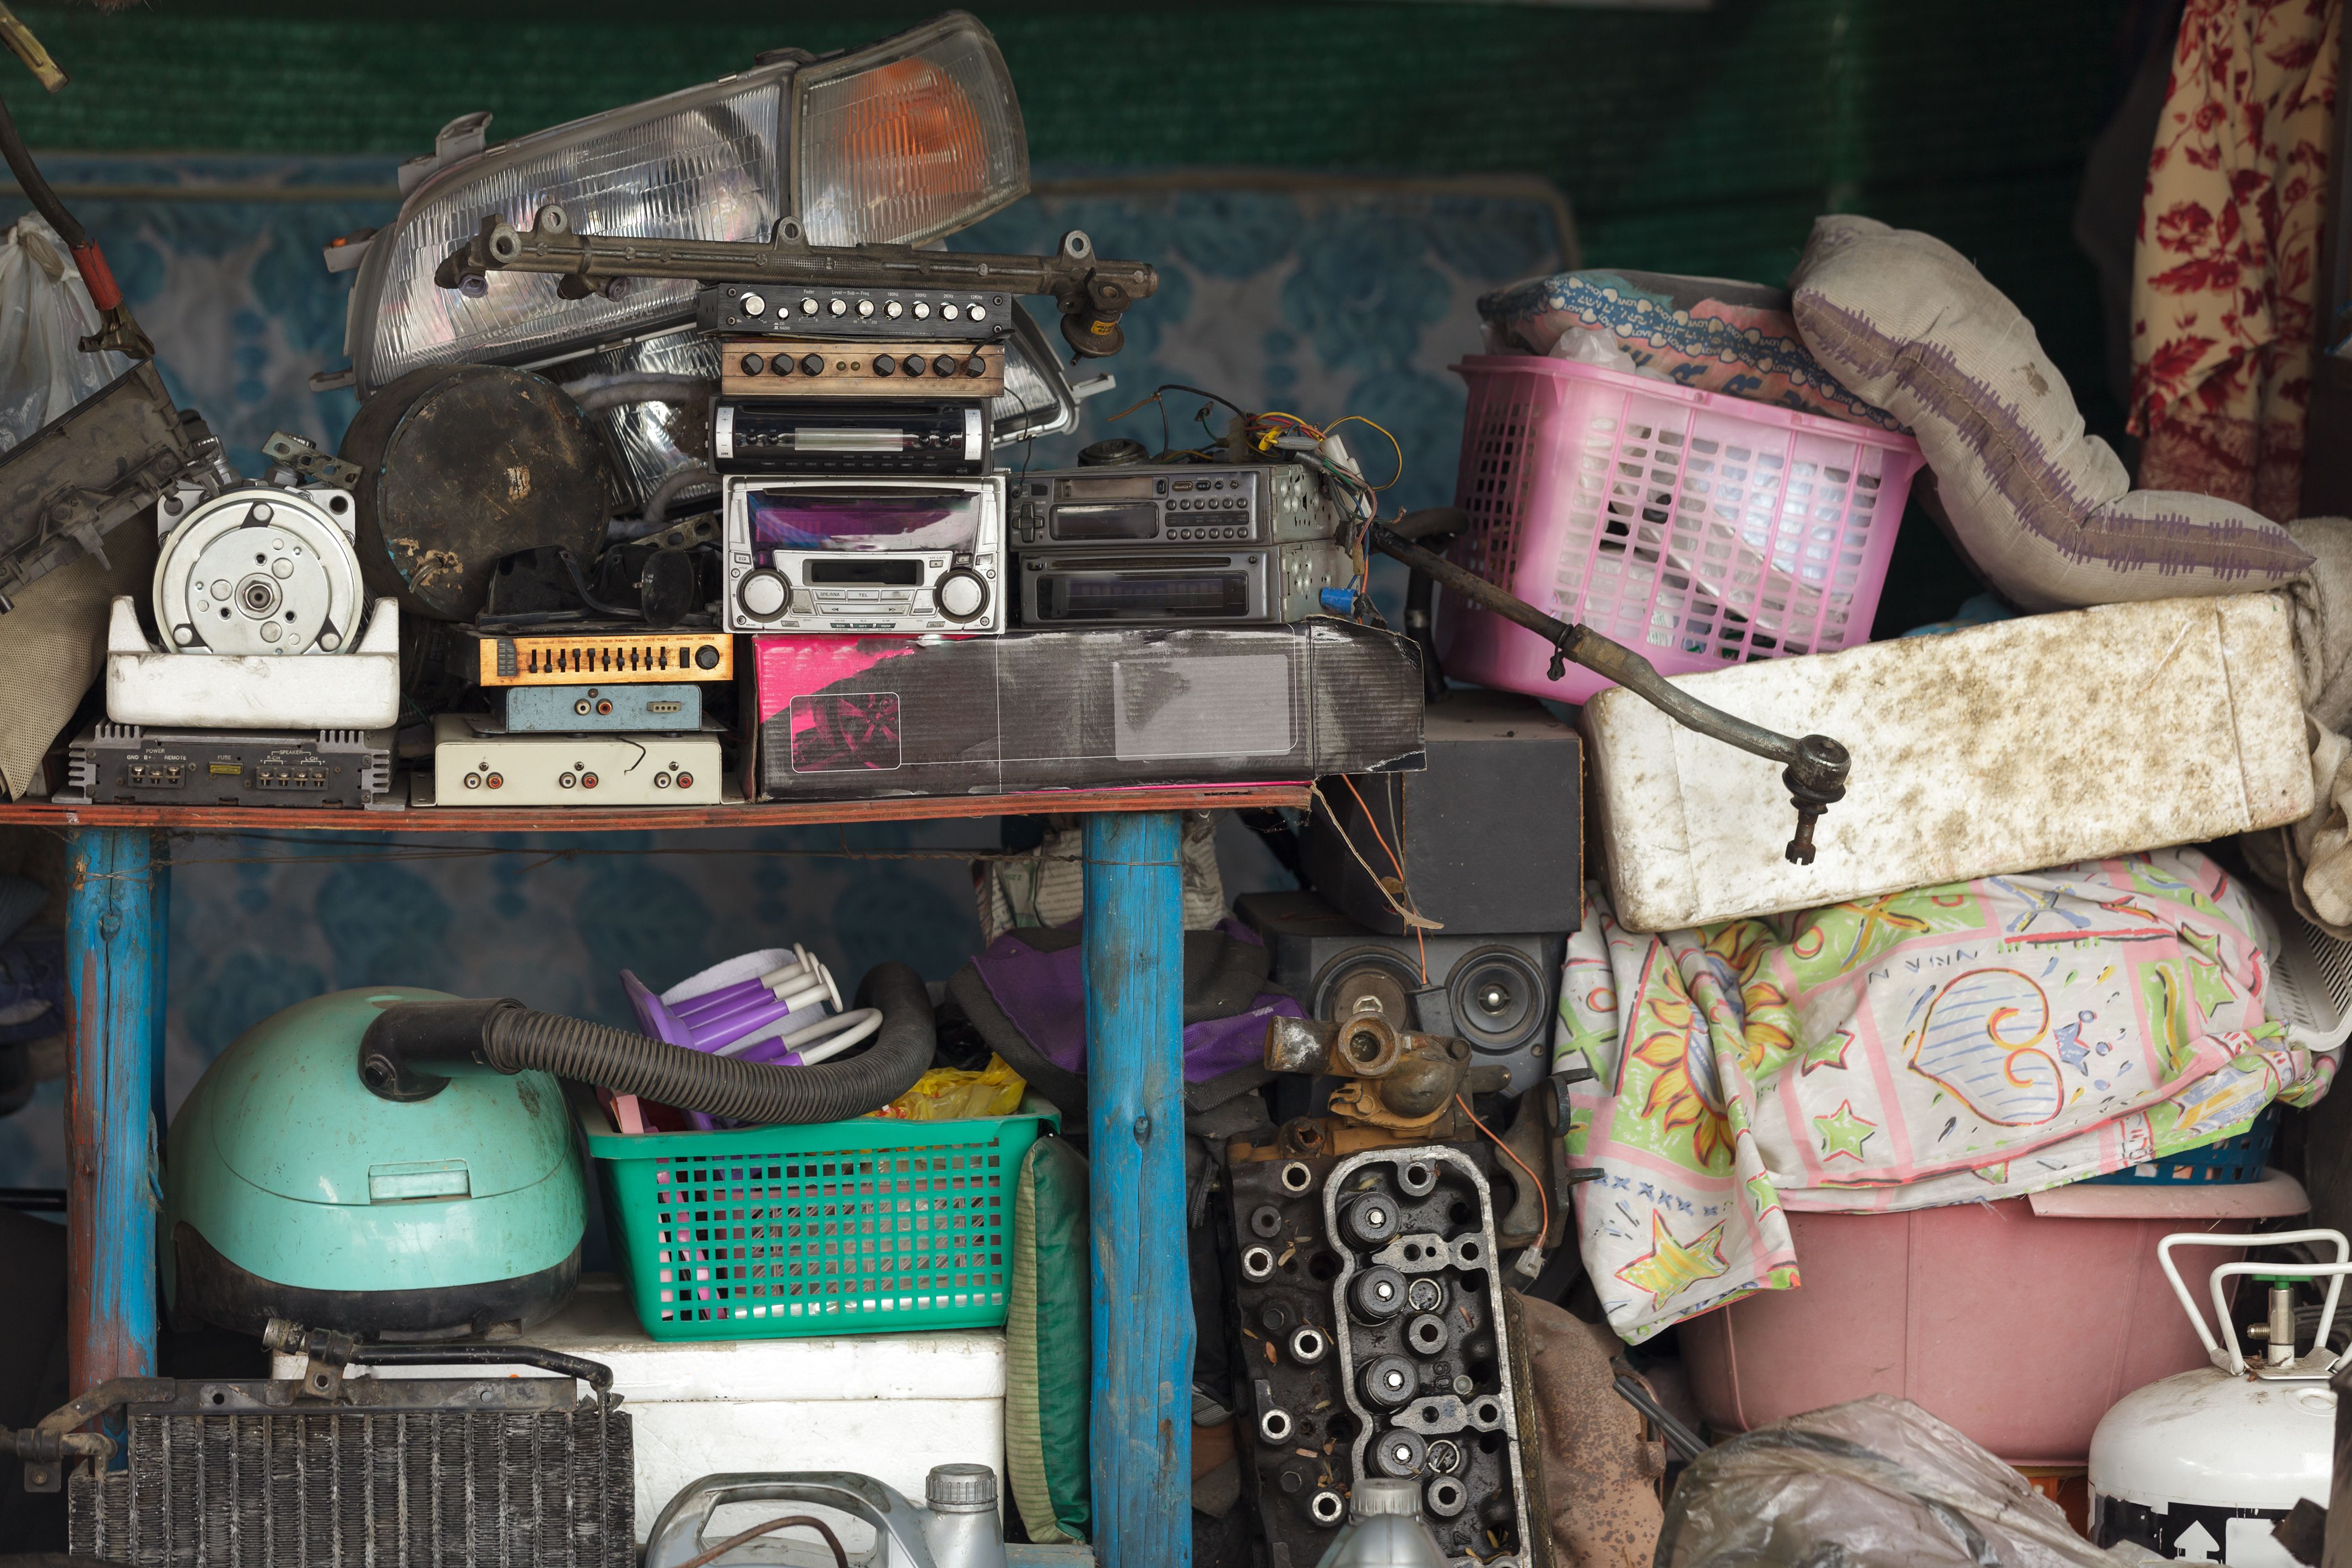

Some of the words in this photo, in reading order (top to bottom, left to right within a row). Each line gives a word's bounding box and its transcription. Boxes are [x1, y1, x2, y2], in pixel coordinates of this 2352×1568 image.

[1585, 283, 1602, 298] LOVE
[1564, 304, 1585, 313] LOVE
[1617, 298, 1637, 306] LOVE
[1654, 305, 1672, 322] LOVE
[1632, 329, 1652, 338] LOVE
[1667, 335, 1685, 352] LOVE
[1738, 351, 1756, 367] LOVE
[1773, 364, 1793, 372] LOVE
[1454, 1531, 1472, 1546] 4
